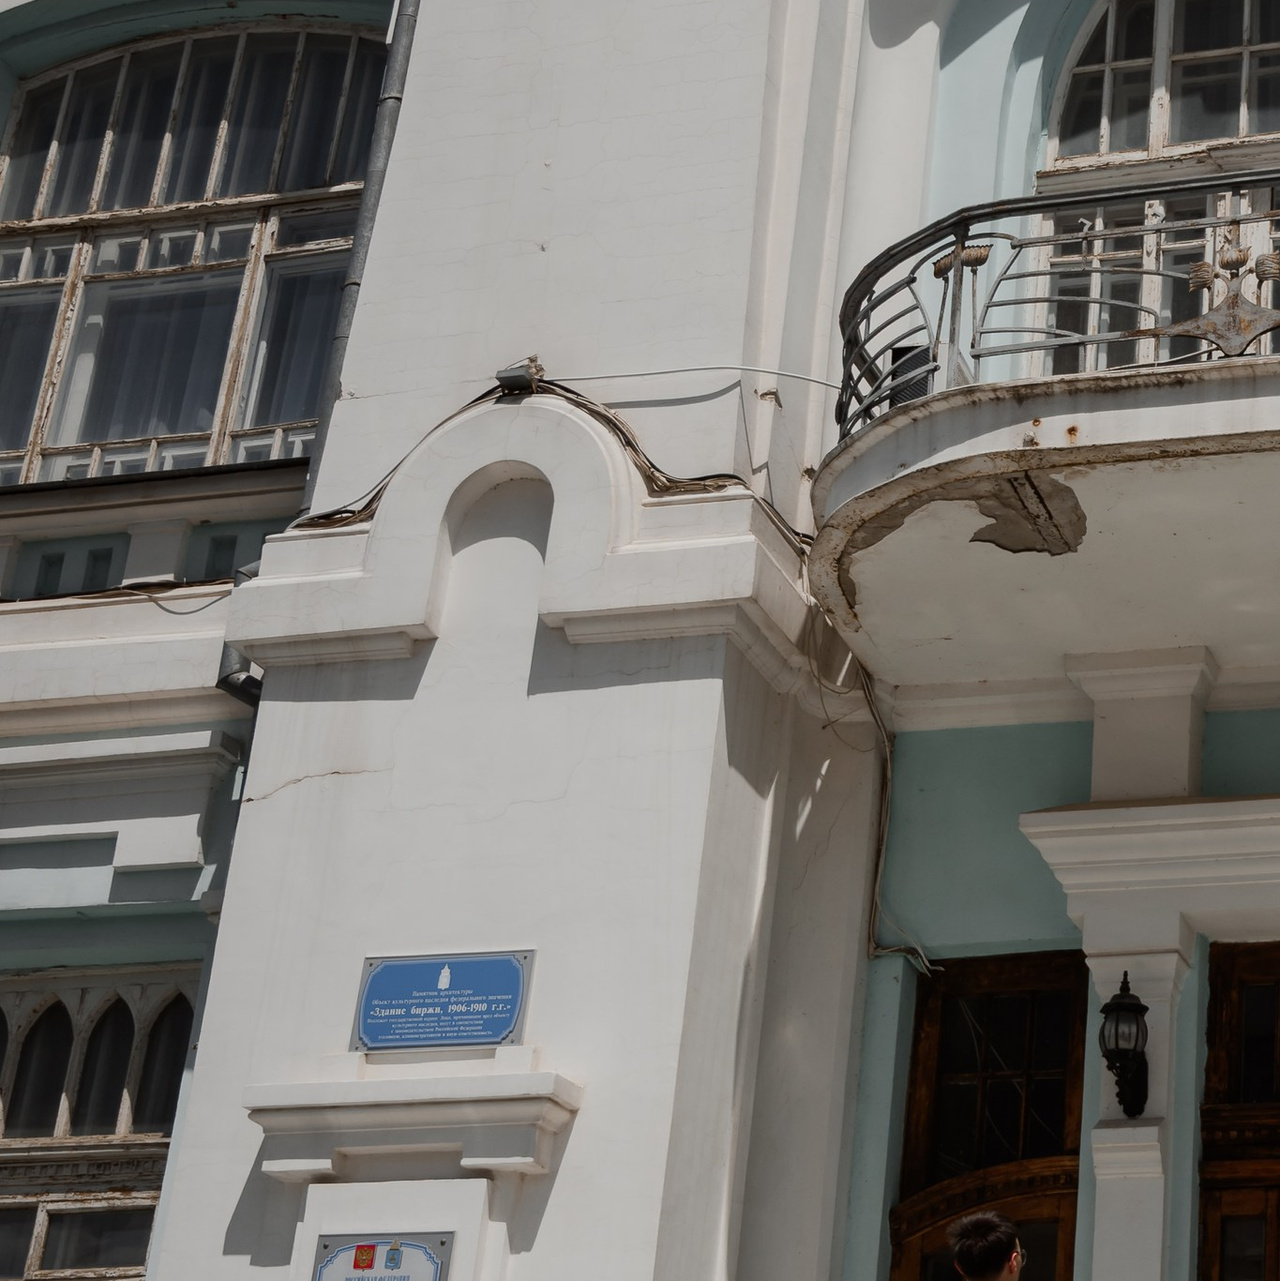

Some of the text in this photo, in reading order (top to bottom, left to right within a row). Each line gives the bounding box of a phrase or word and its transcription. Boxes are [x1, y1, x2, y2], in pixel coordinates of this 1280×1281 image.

[370, 1002, 512, 1017] «Здание биржи, 1906-1910 г.г.»
